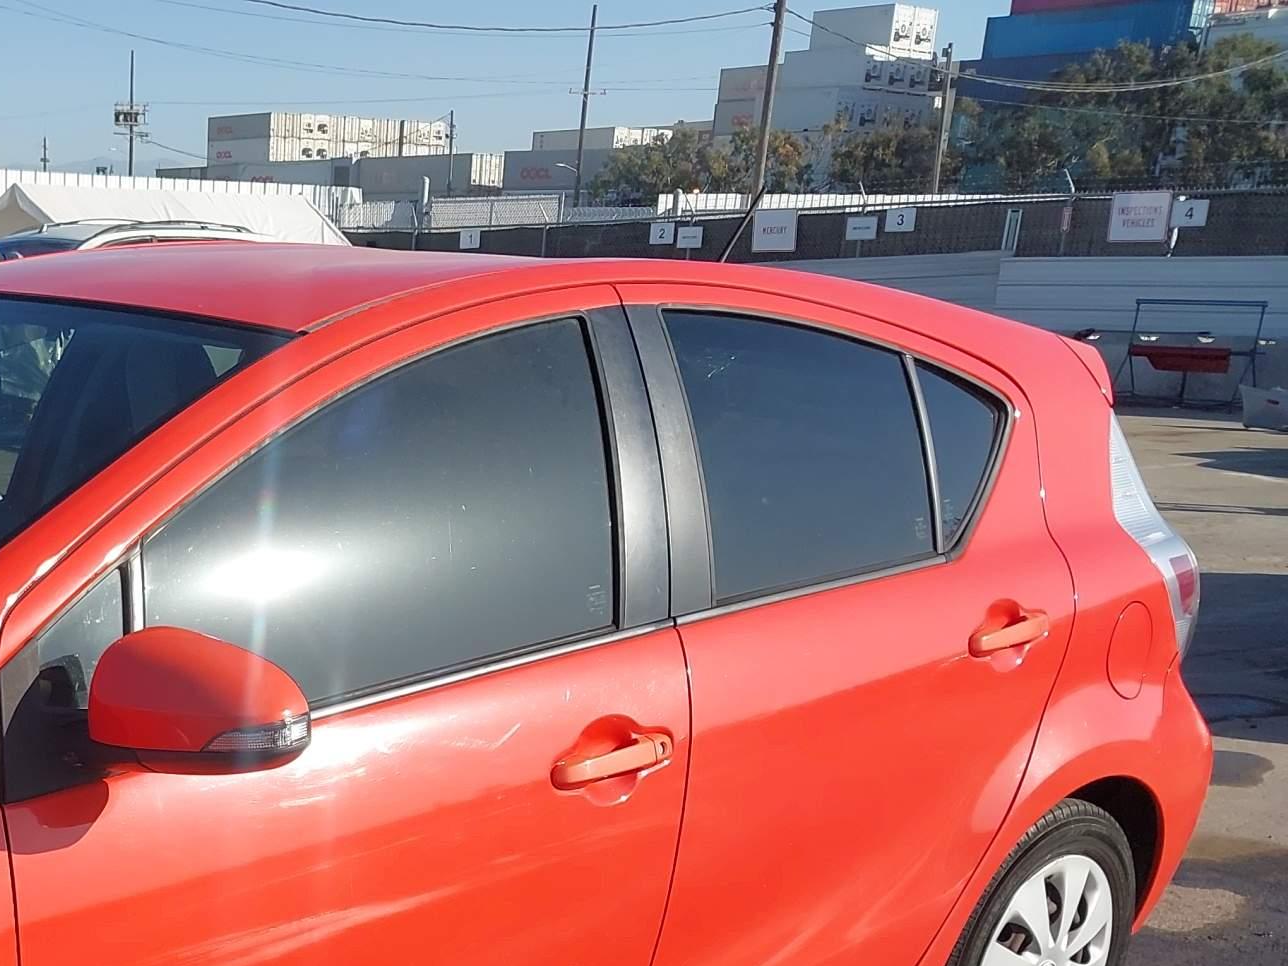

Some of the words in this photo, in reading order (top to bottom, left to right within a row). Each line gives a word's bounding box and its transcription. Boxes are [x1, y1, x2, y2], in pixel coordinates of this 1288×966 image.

[1184, 207, 1194, 220] 4
[896, 214, 904, 226] 3
[468, 234, 474, 244] 1
[657, 227, 666, 239] 2
